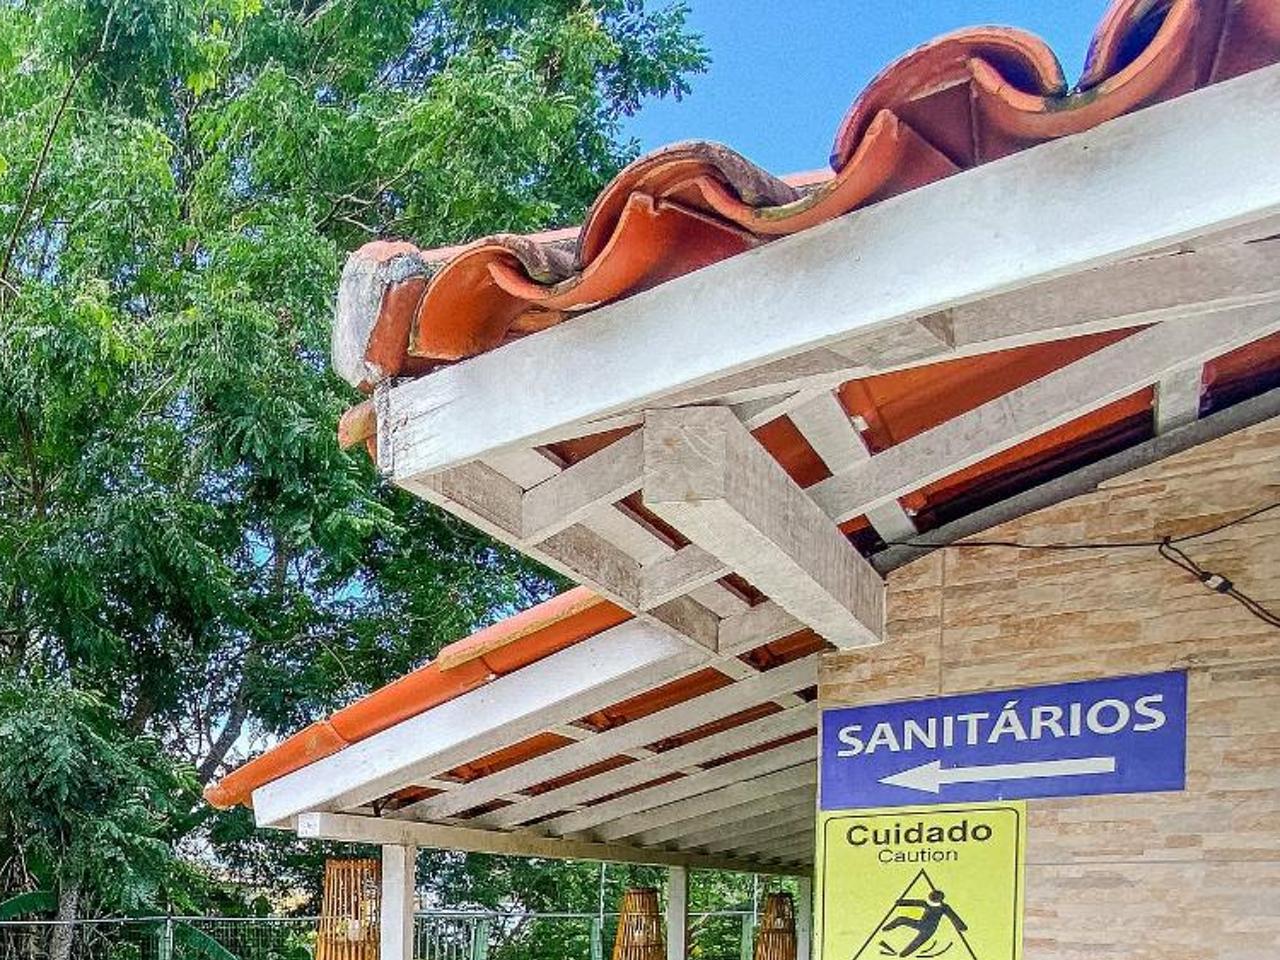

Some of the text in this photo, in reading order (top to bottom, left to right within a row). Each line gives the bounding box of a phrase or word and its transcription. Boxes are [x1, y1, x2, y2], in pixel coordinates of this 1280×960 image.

[837, 694, 1167, 757] SANITÁRIOS
[846, 820, 993, 846] Cuidado
[878, 848, 959, 864] Caution
